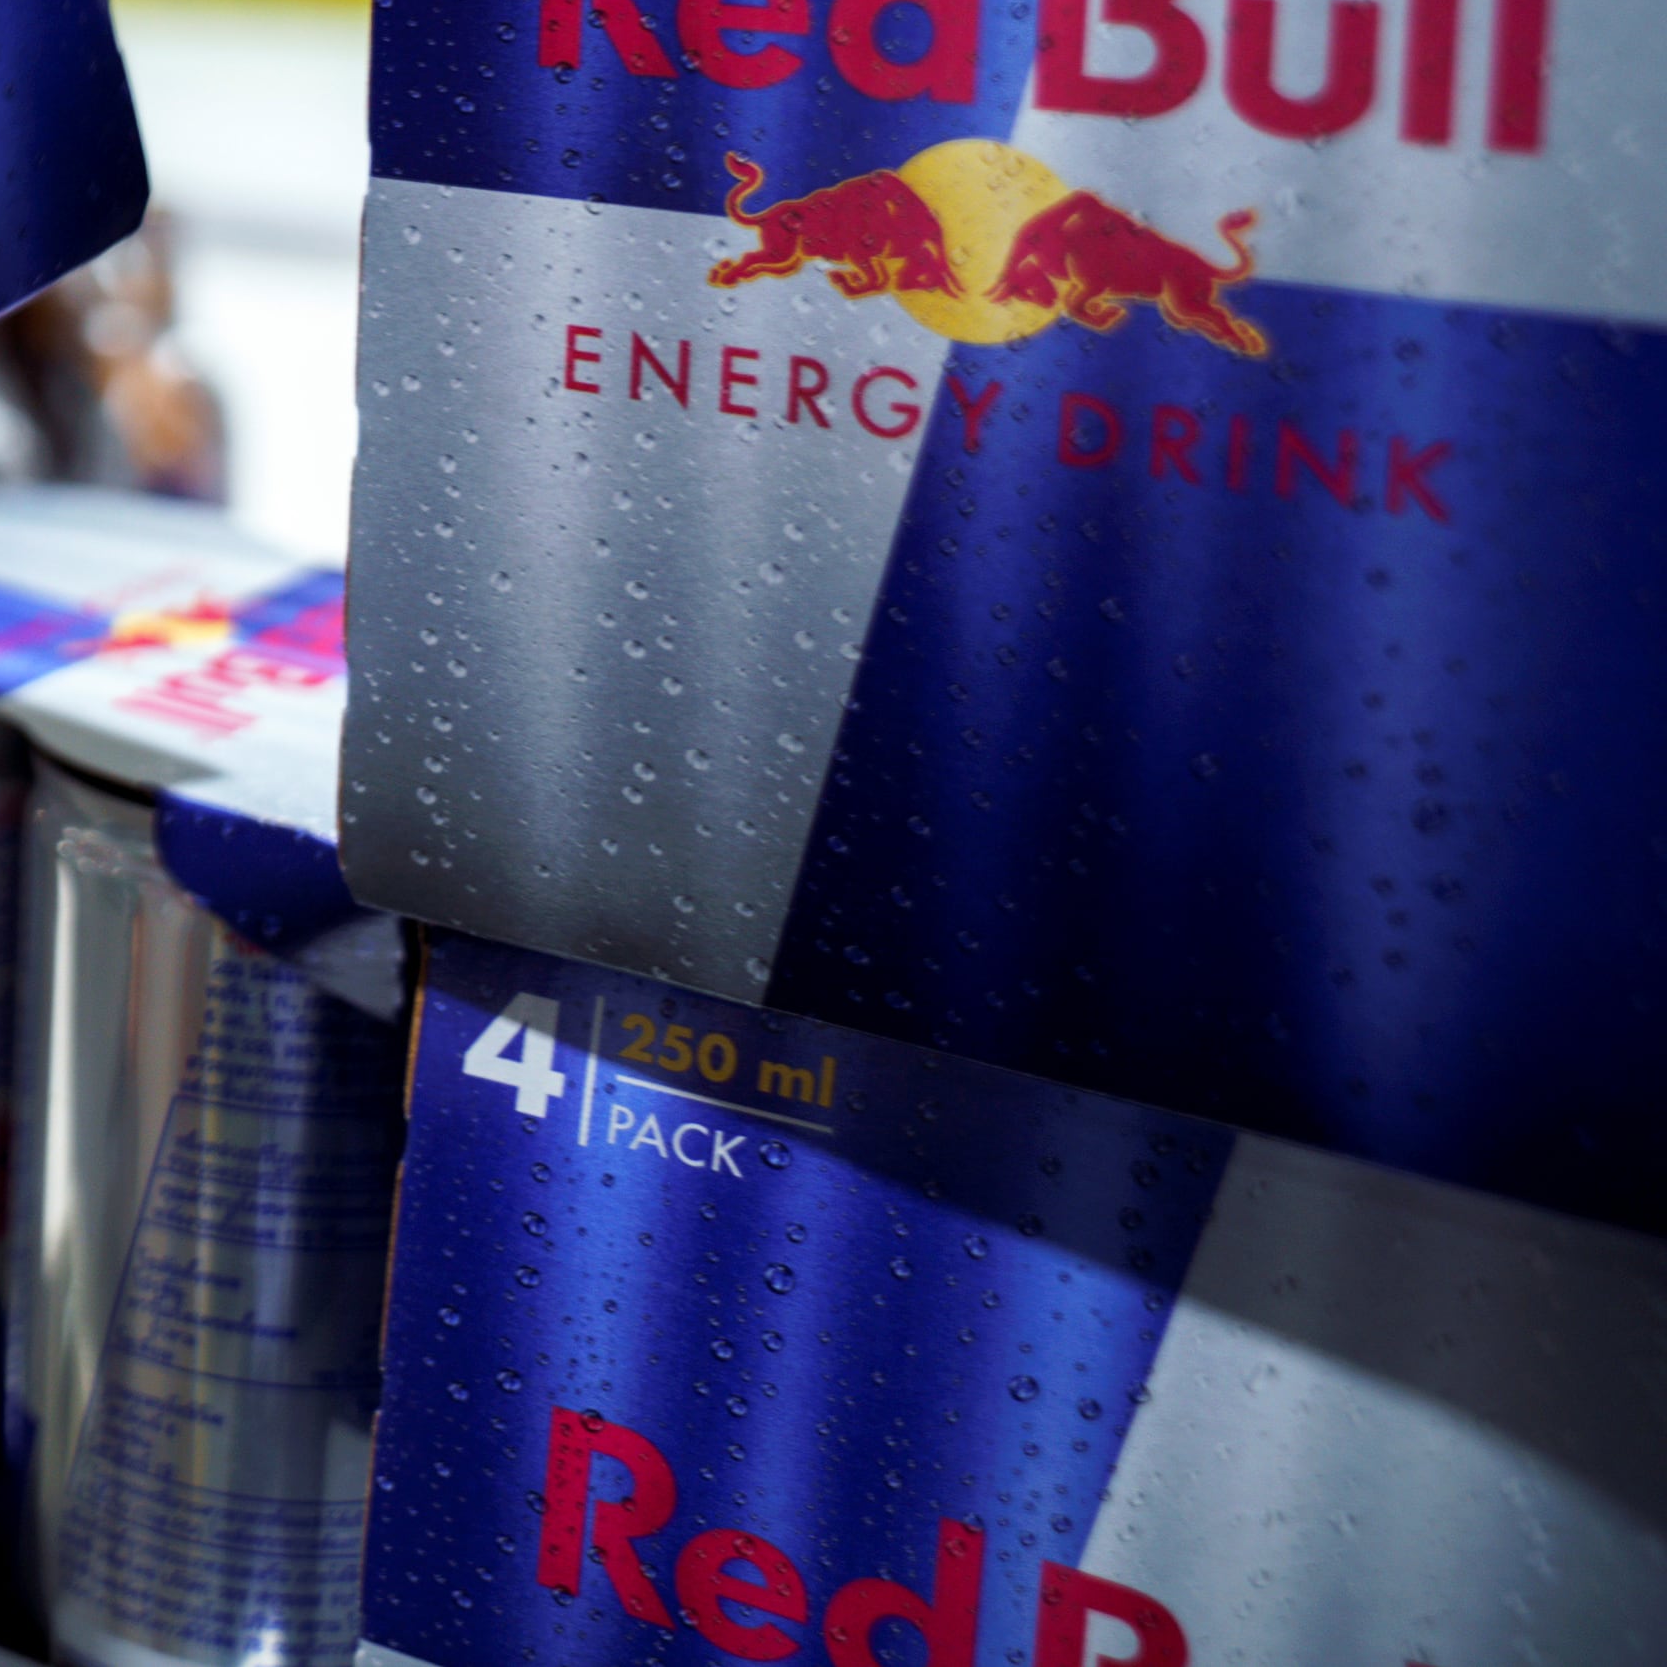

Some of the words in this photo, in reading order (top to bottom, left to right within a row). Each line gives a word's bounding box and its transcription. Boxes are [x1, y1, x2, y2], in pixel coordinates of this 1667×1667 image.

[563, 323, 1002, 454] ENERGY
[1057, 392, 1455, 526] DRINK
[462, 991, 565, 1119] 4
[617, 1013, 738, 1083] 250
[756, 1055, 837, 1108] ml
[608, 1104, 746, 1179] PACK
[536, 1405, 985, 1667] Red
